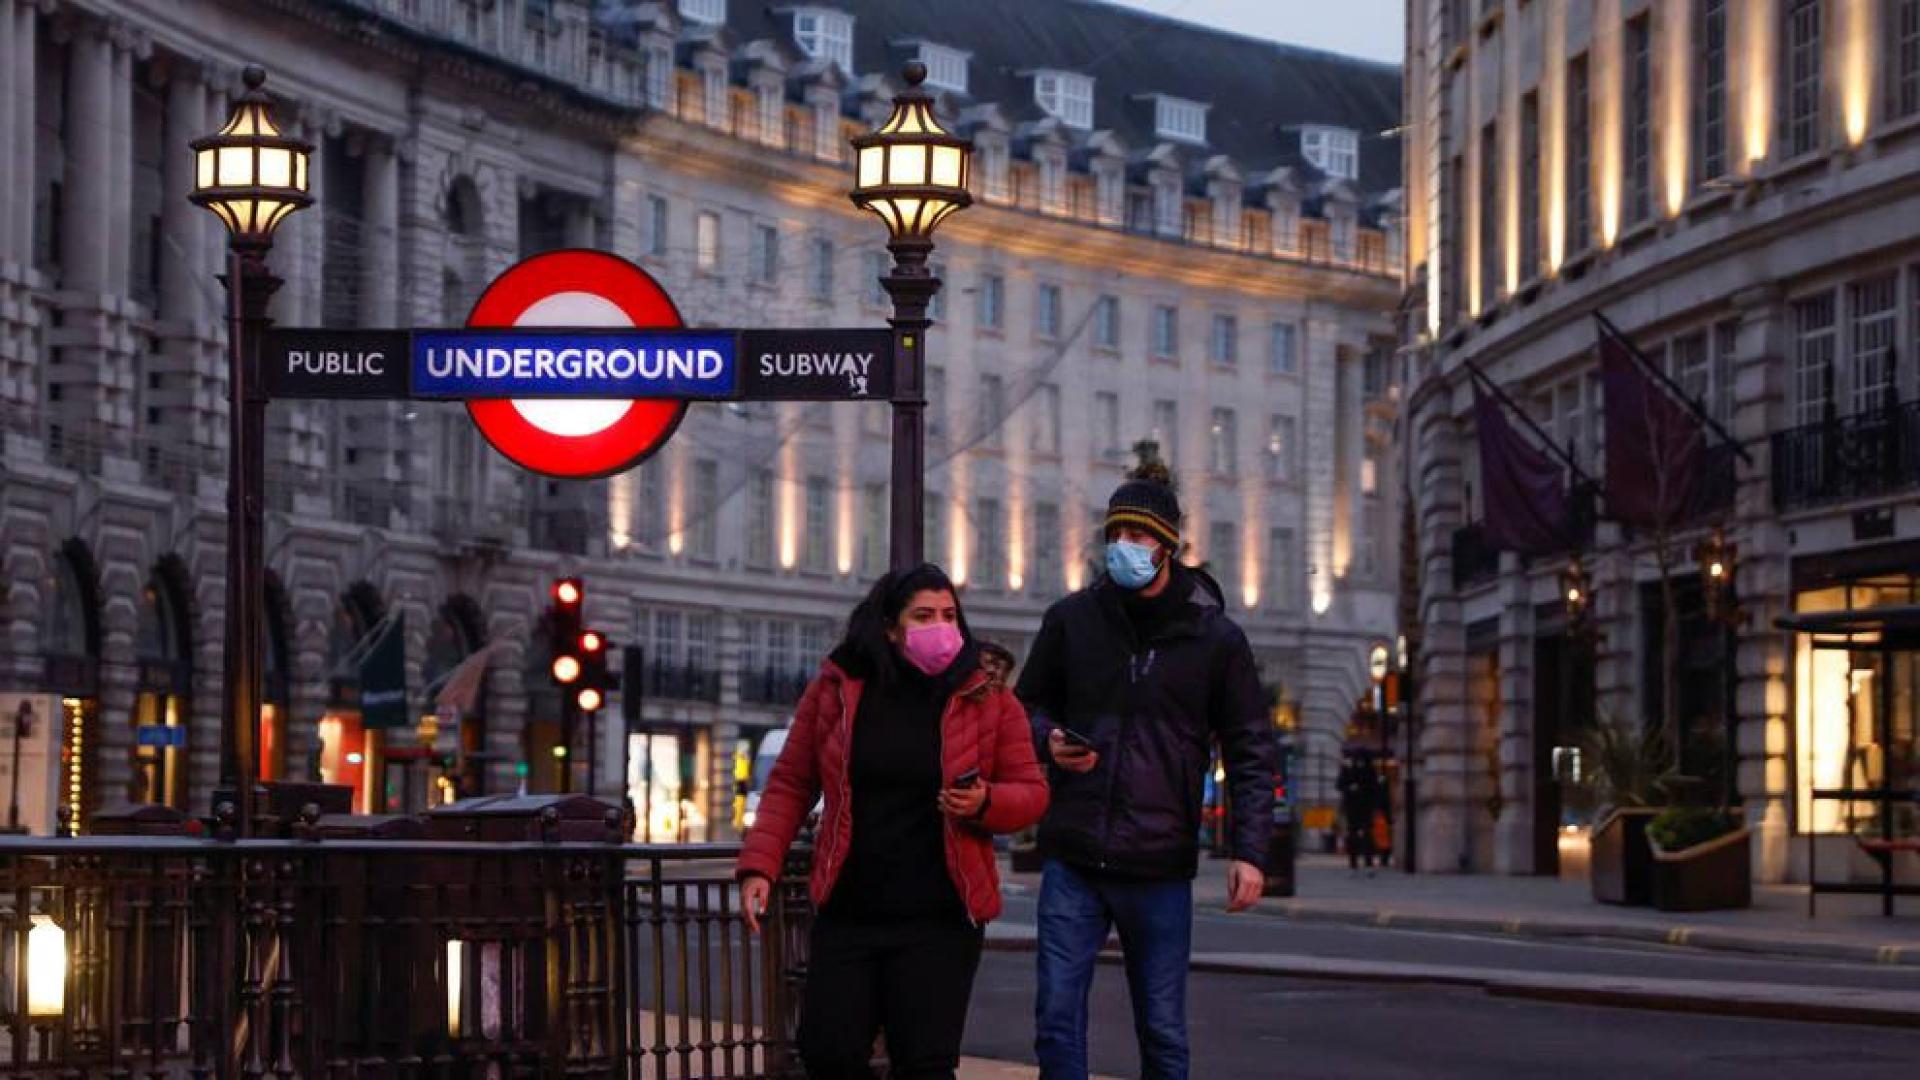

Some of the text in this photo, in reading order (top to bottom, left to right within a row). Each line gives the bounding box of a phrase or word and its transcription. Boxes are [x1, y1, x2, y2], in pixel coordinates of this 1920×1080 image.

[288, 348, 874, 379] PUBLIC UNDERGROUND SUBWAY
